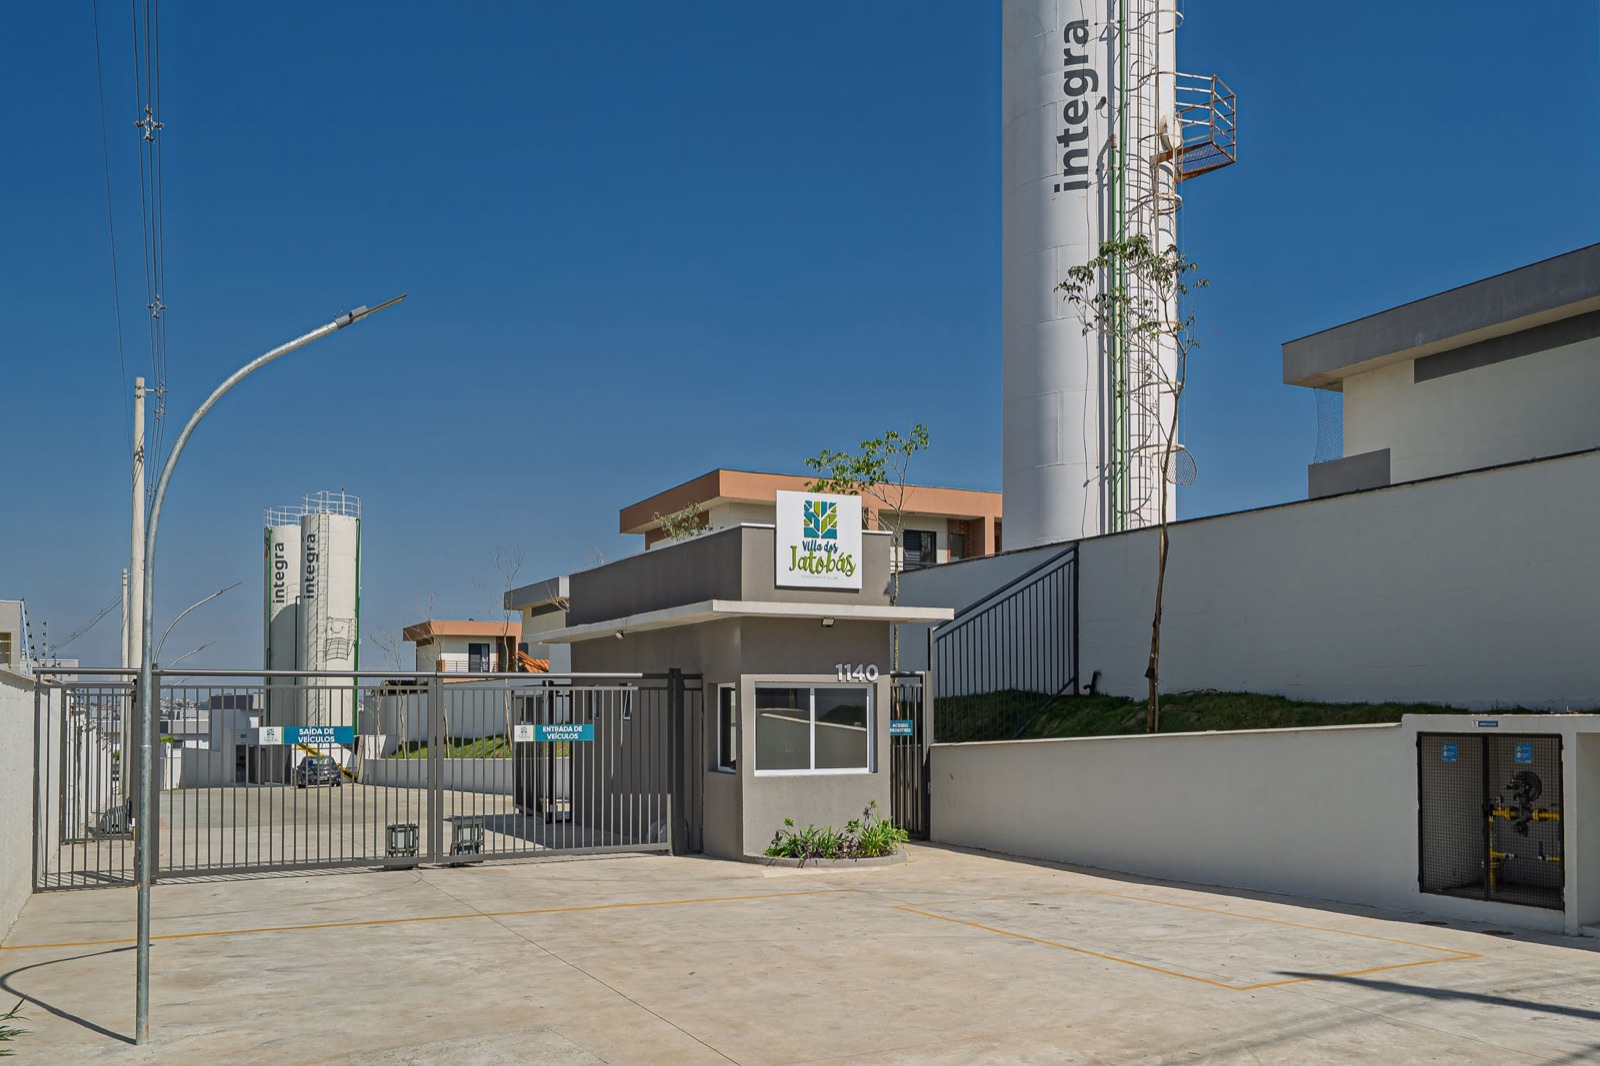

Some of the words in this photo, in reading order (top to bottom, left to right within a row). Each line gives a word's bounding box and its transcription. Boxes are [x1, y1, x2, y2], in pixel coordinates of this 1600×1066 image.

[1054, 19, 1098, 193] integra
[802, 540, 822, 552] Villa
[824, 541, 839, 555] dos
[304, 533, 319, 600] integra
[789, 545, 856, 577] Jatobás
[273, 542, 288, 604] integra
[835, 663, 879, 681] 1140
[297, 734, 336, 743] VEÍCULOS
[299, 726, 322, 735] SAÍDA
[324, 727, 335, 735] DE
[546, 732, 579, 740] VEÍCULOS
